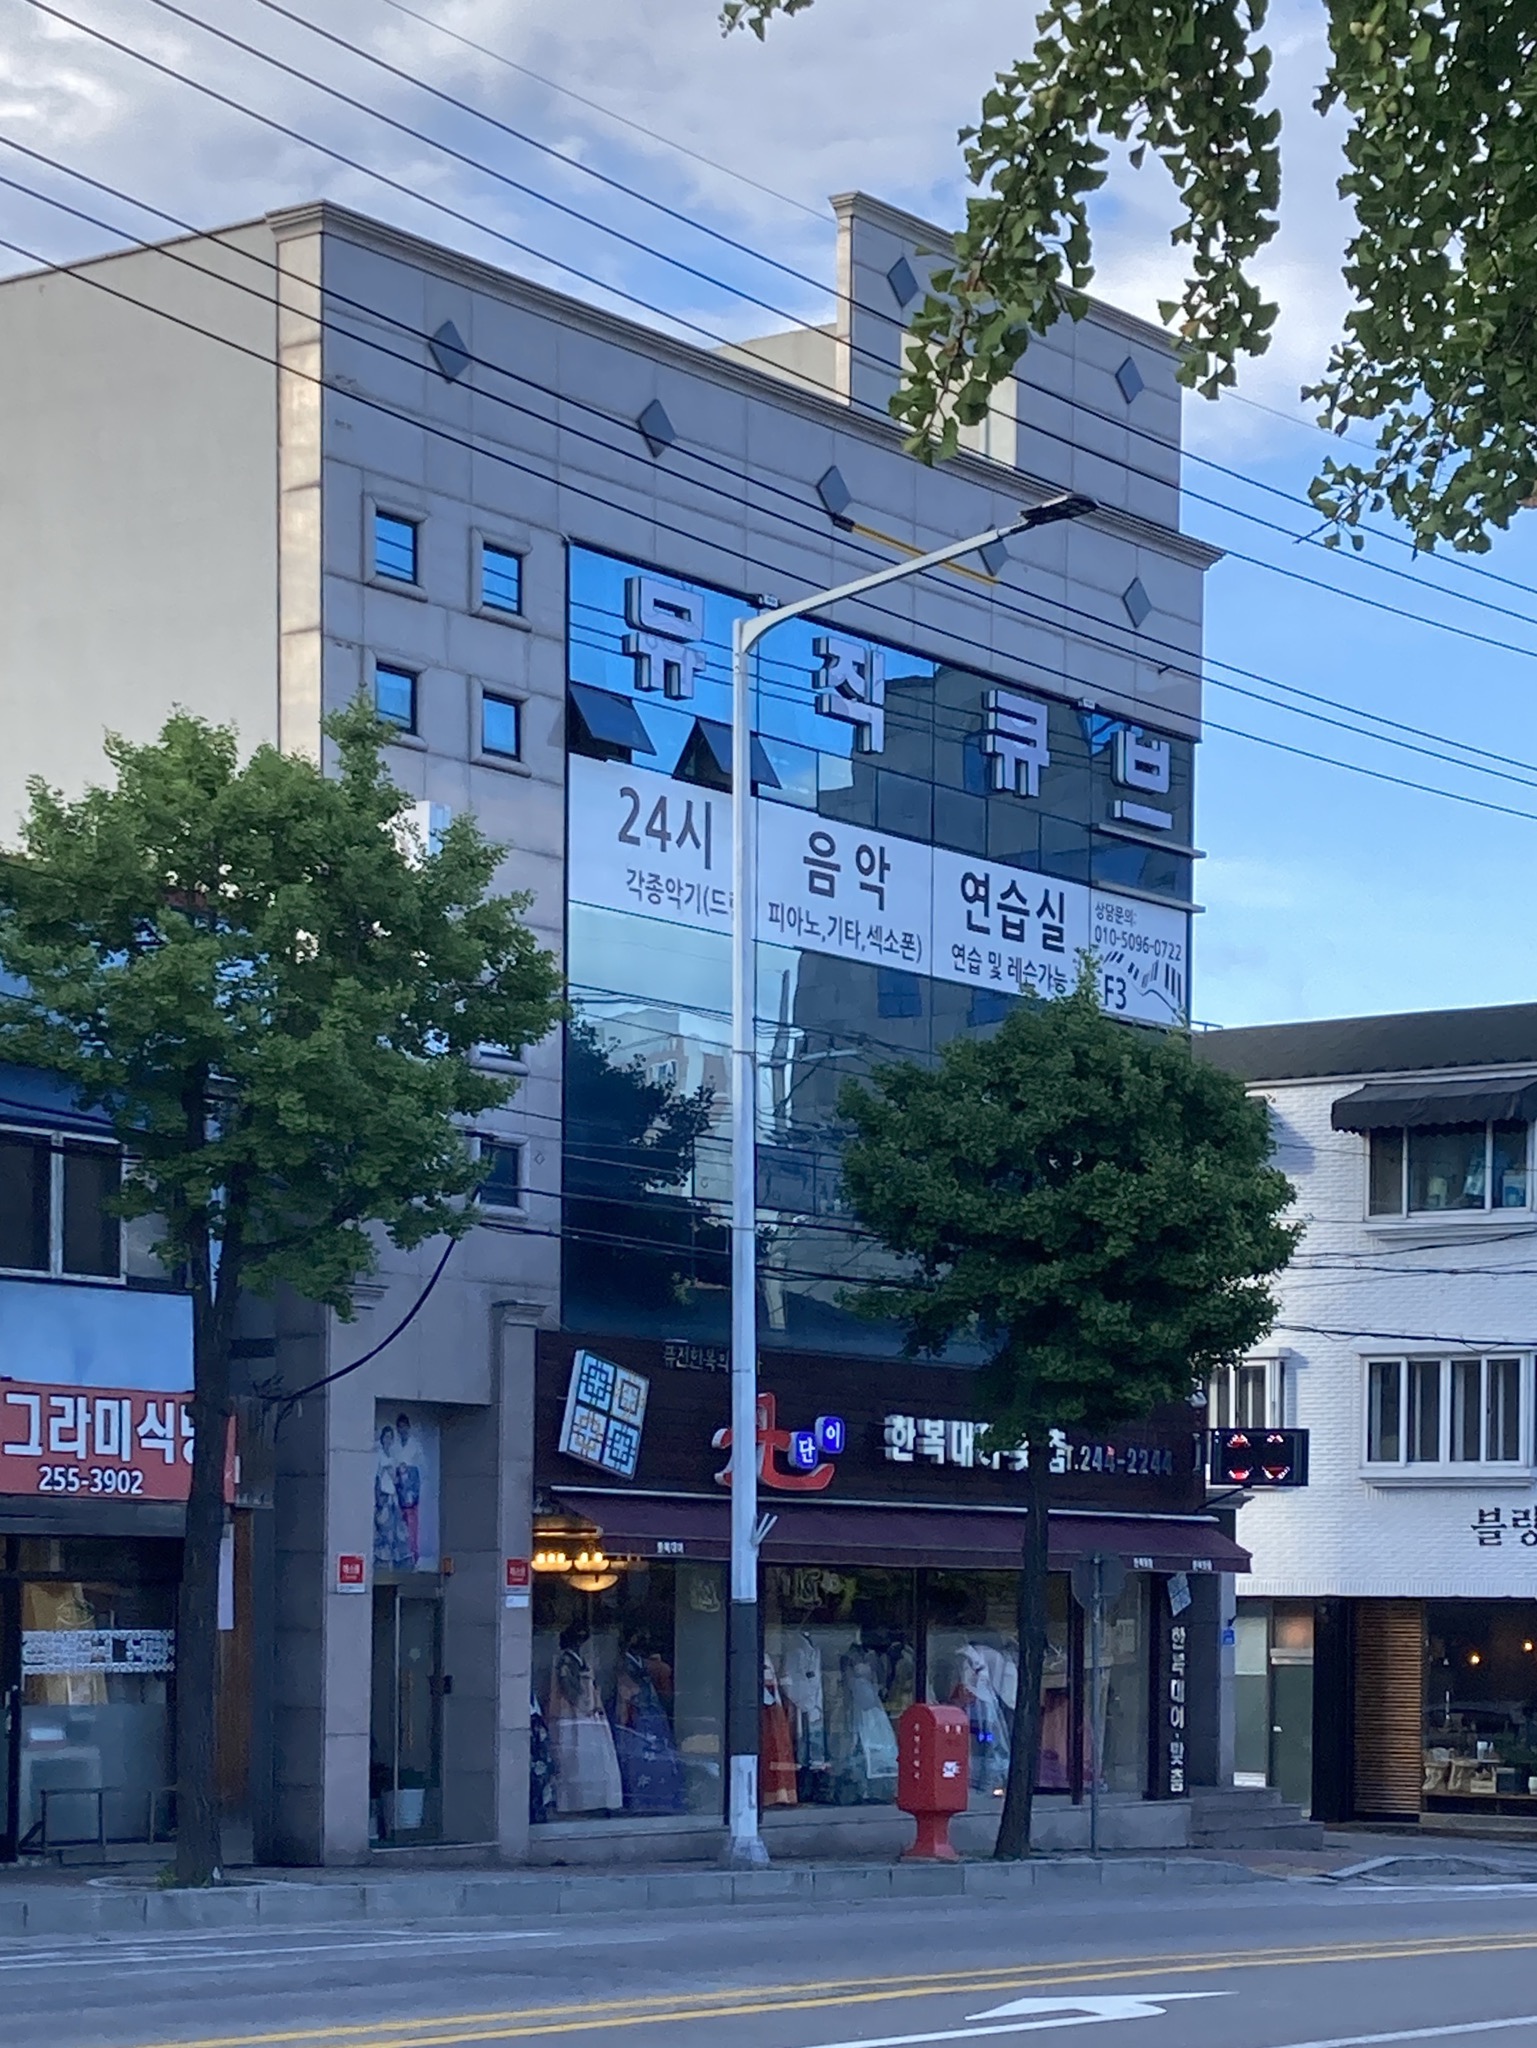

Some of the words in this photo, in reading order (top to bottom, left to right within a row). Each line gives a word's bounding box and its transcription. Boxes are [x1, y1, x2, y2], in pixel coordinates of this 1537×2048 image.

[624, 575, 1172, 830] 뮤직큐브
[617, 786, 711, 870] 24시
[803, 831, 890, 911] 음악
[960, 871, 1065, 954] 연습실
[626, 868, 733, 917] 각종악기(드
[951, 943, 983, 975] 연습
[988, 951, 1003, 981] 및
[1094, 925, 1182, 962] 010-5096-0722
[38, 1465, 144, 1495] 255-3902
